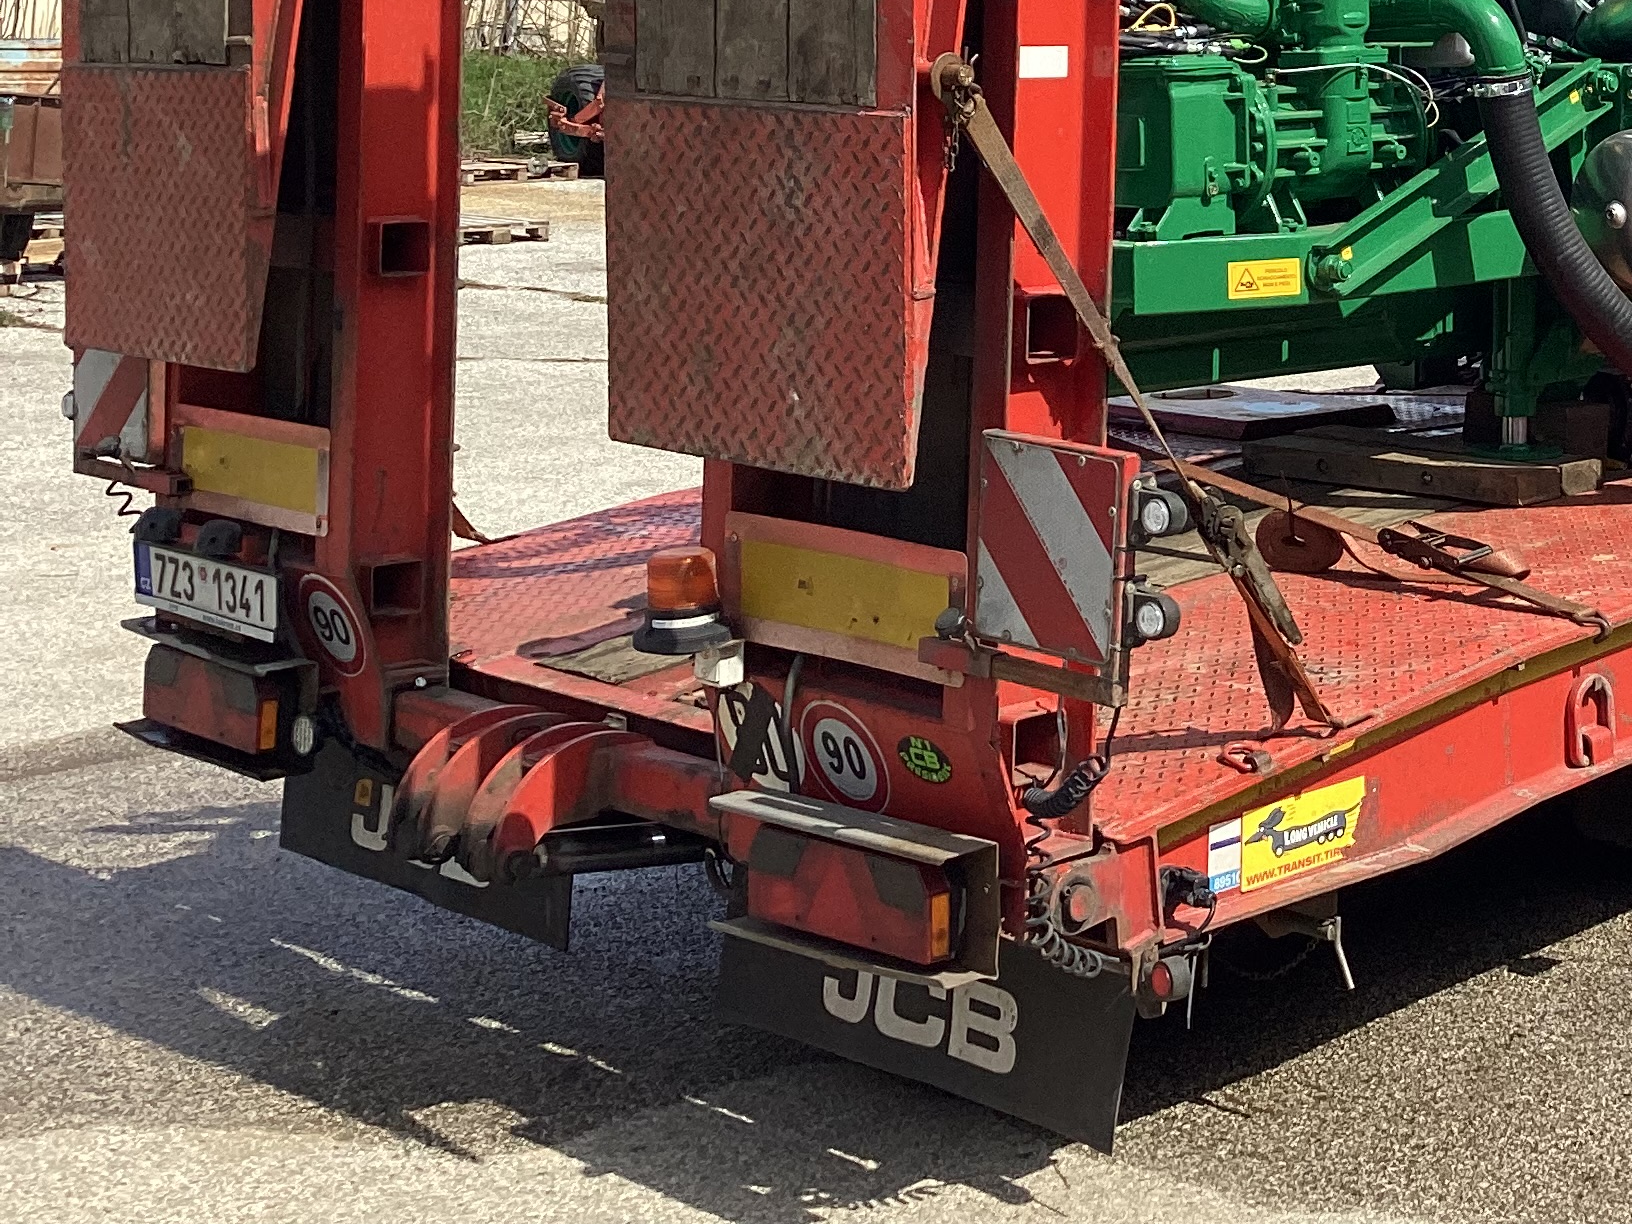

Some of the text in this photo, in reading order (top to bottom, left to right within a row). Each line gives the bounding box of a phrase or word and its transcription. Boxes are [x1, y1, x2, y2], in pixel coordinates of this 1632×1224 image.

[154, 553, 265, 622] 7Z3 1341
[313, 605, 351, 645] 90
[821, 730, 867, 780] 90
[1285, 827, 1307, 844] LONG
[823, 970, 1018, 1074] JCB
